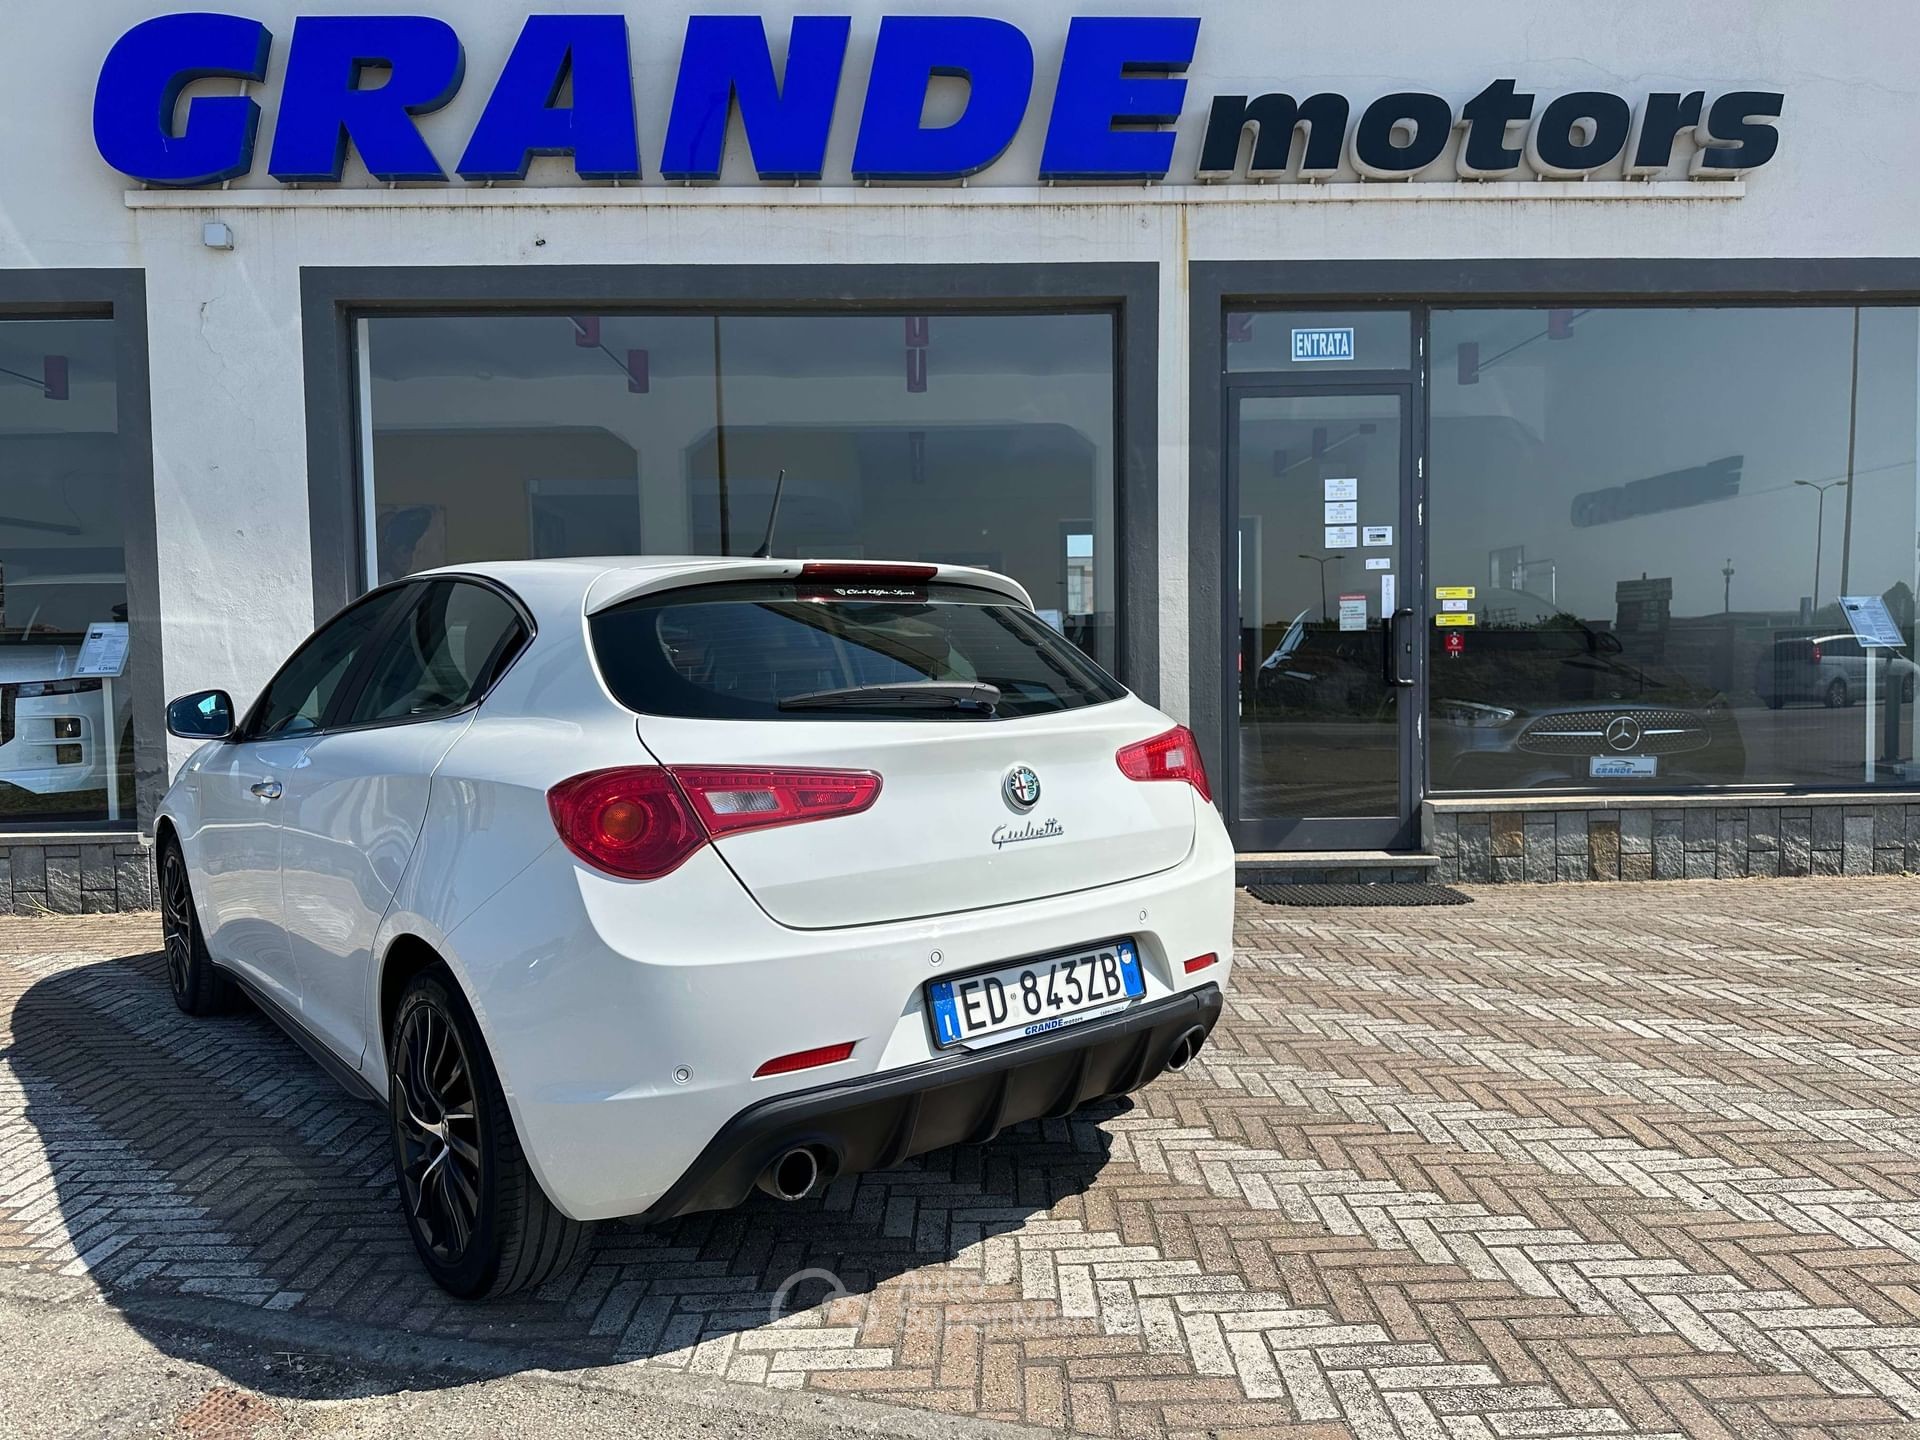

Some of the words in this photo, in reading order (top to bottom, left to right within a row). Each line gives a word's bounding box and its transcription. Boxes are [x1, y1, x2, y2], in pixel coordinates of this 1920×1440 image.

[93, 12, 1201, 185] GRANDE
[1199, 78, 1784, 176] motors
[1296, 332, 1349, 356] ENTRATA
[991, 818, 1064, 849] Giulietta
[959, 976, 1008, 1031] ED
[1020, 952, 1121, 1015] 843ZB
[1024, 1018, 1064, 1036] GRANDE
